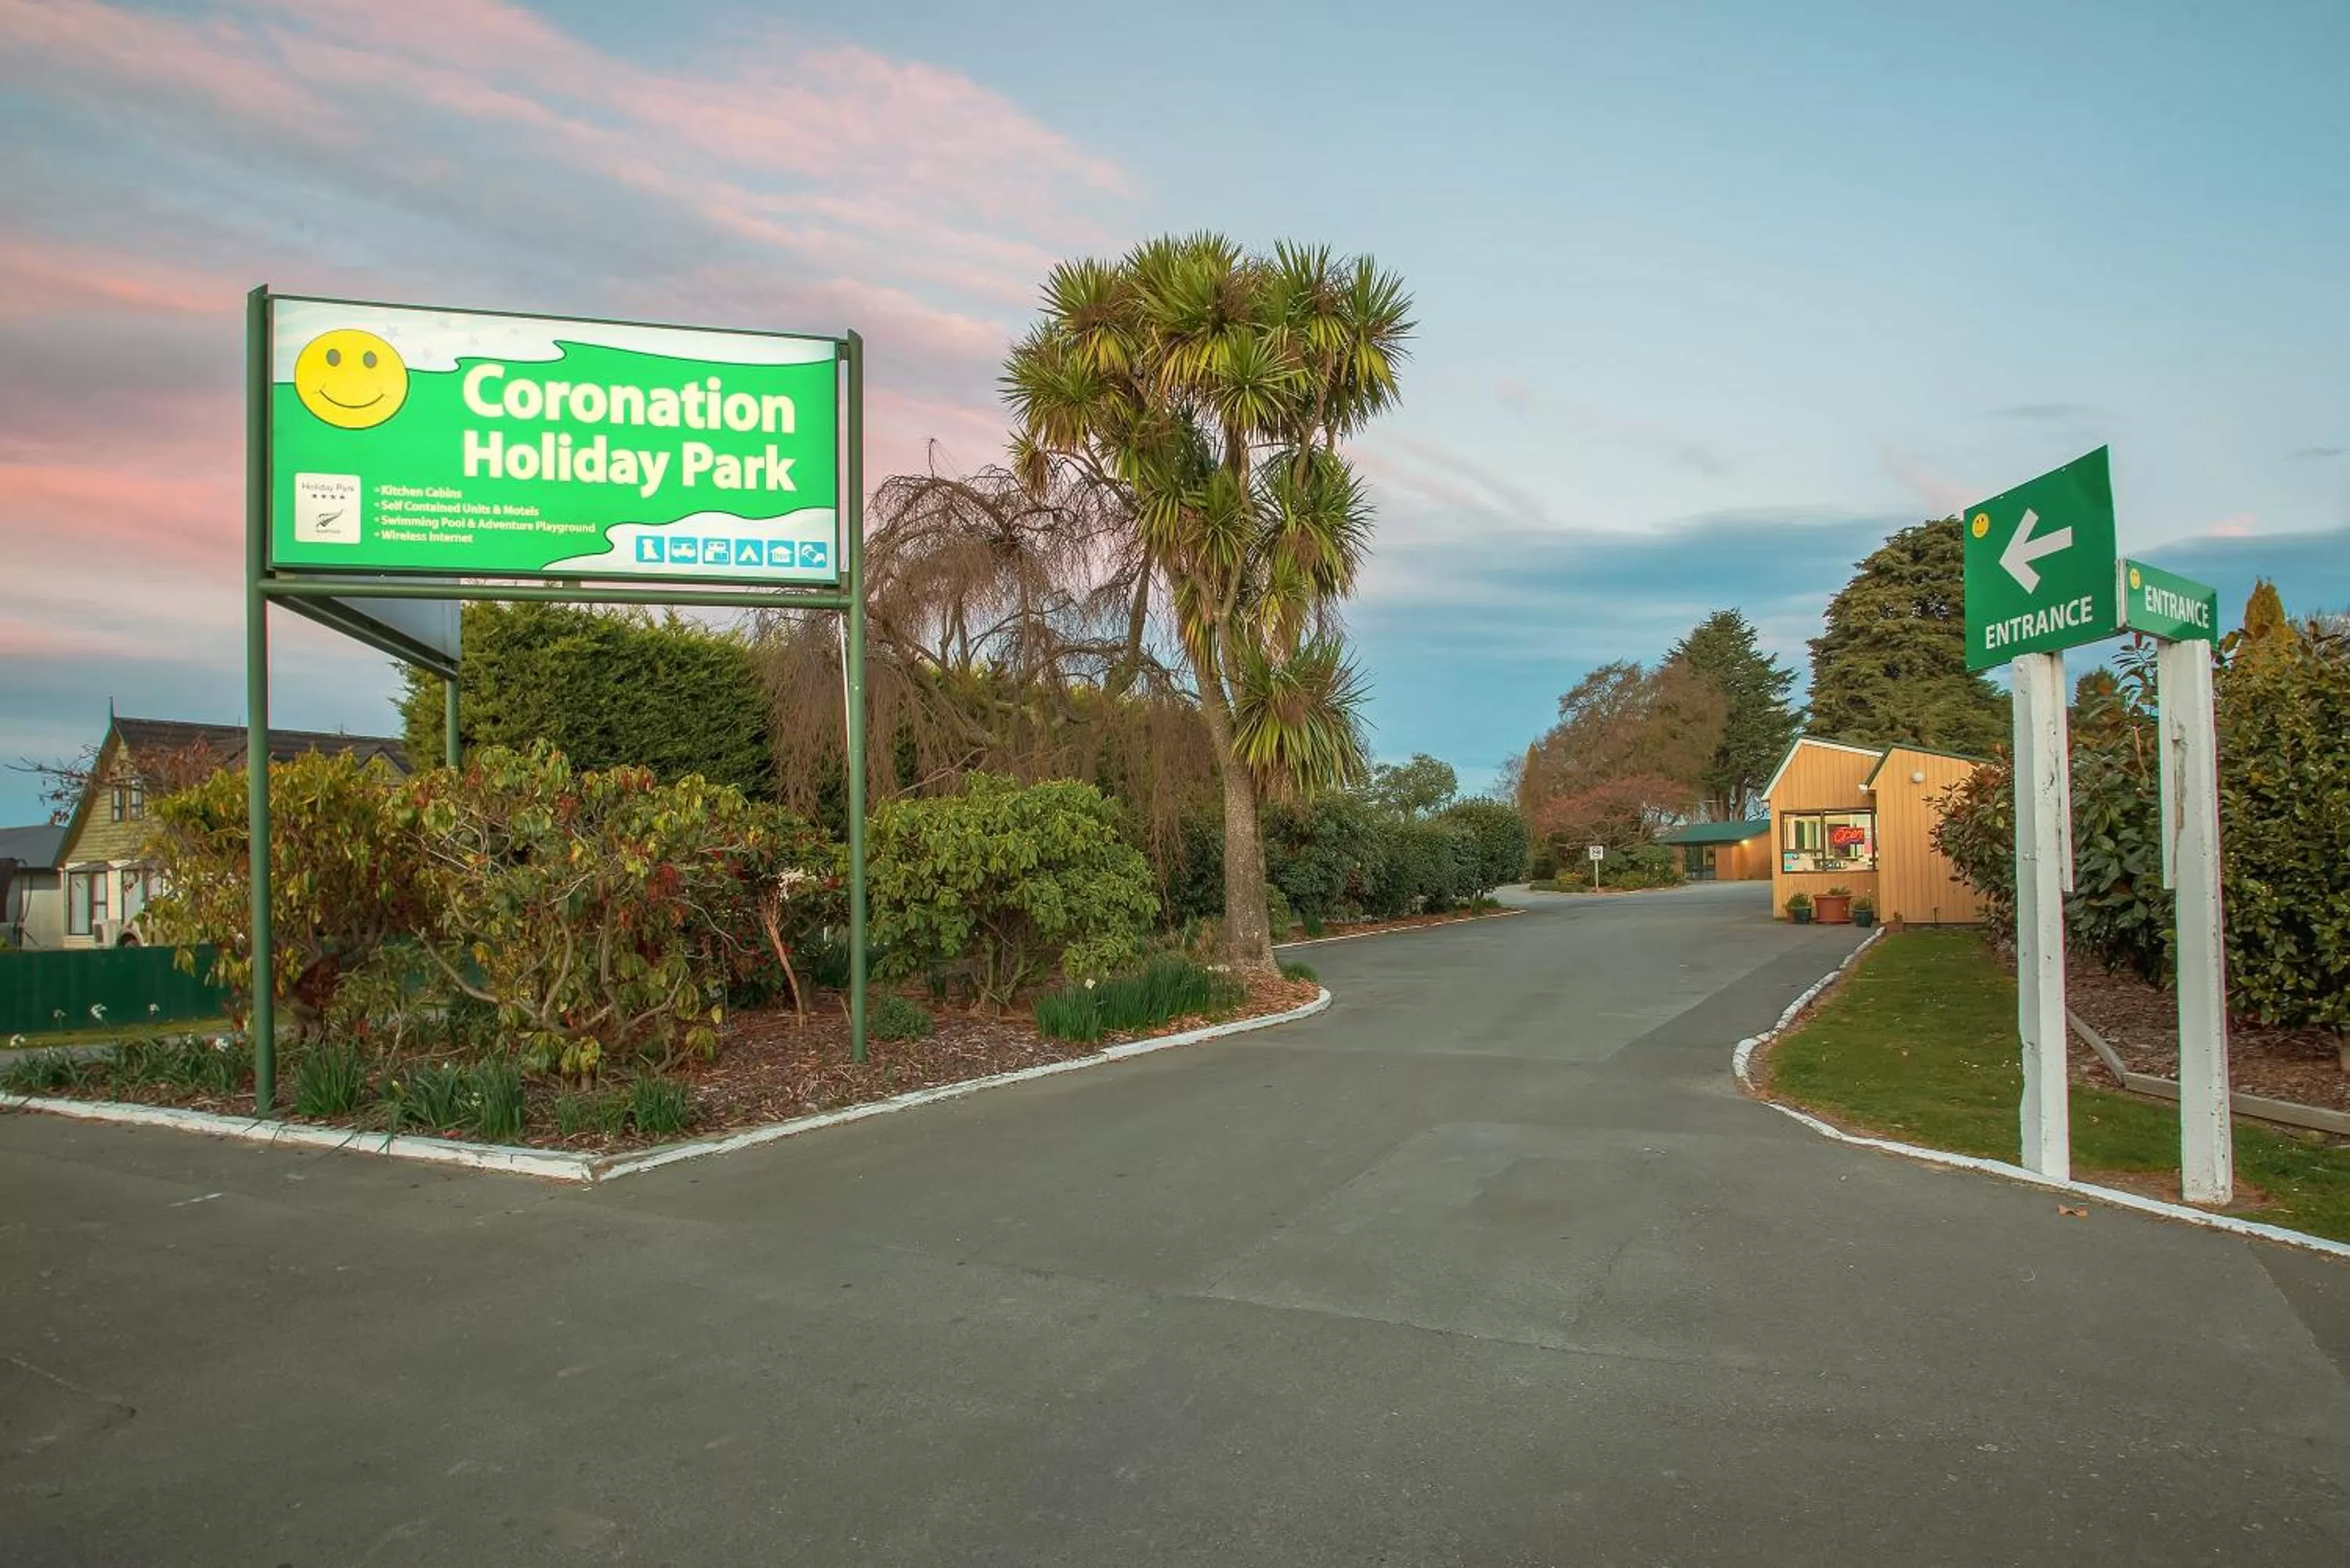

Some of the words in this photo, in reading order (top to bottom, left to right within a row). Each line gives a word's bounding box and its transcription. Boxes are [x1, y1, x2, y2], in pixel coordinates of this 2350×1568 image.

[462, 363, 796, 434] Coronation
[463, 430, 671, 498] Holiday
[682, 442, 797, 492] Park
[381, 486, 424, 497] Kitchen
[425, 486, 462, 499] Cabins
[381, 500, 403, 511] Self
[403, 500, 461, 513] Contained
[462, 503, 491, 515] Units
[493, 504, 502, 515] &
[503, 504, 540, 516] Motels
[381, 515, 439, 529] Swimming
[440, 517, 466, 528] Pool
[467, 518, 476, 529] &
[478, 518, 533, 529] Adventure
[535, 520, 596, 534] Playground
[381, 529, 427, 541] Wireless
[428, 530, 473, 543] Internet
[1985, 595, 2093, 649] ENTRANCE
[2144, 585, 2210, 628] ENTRANCE
